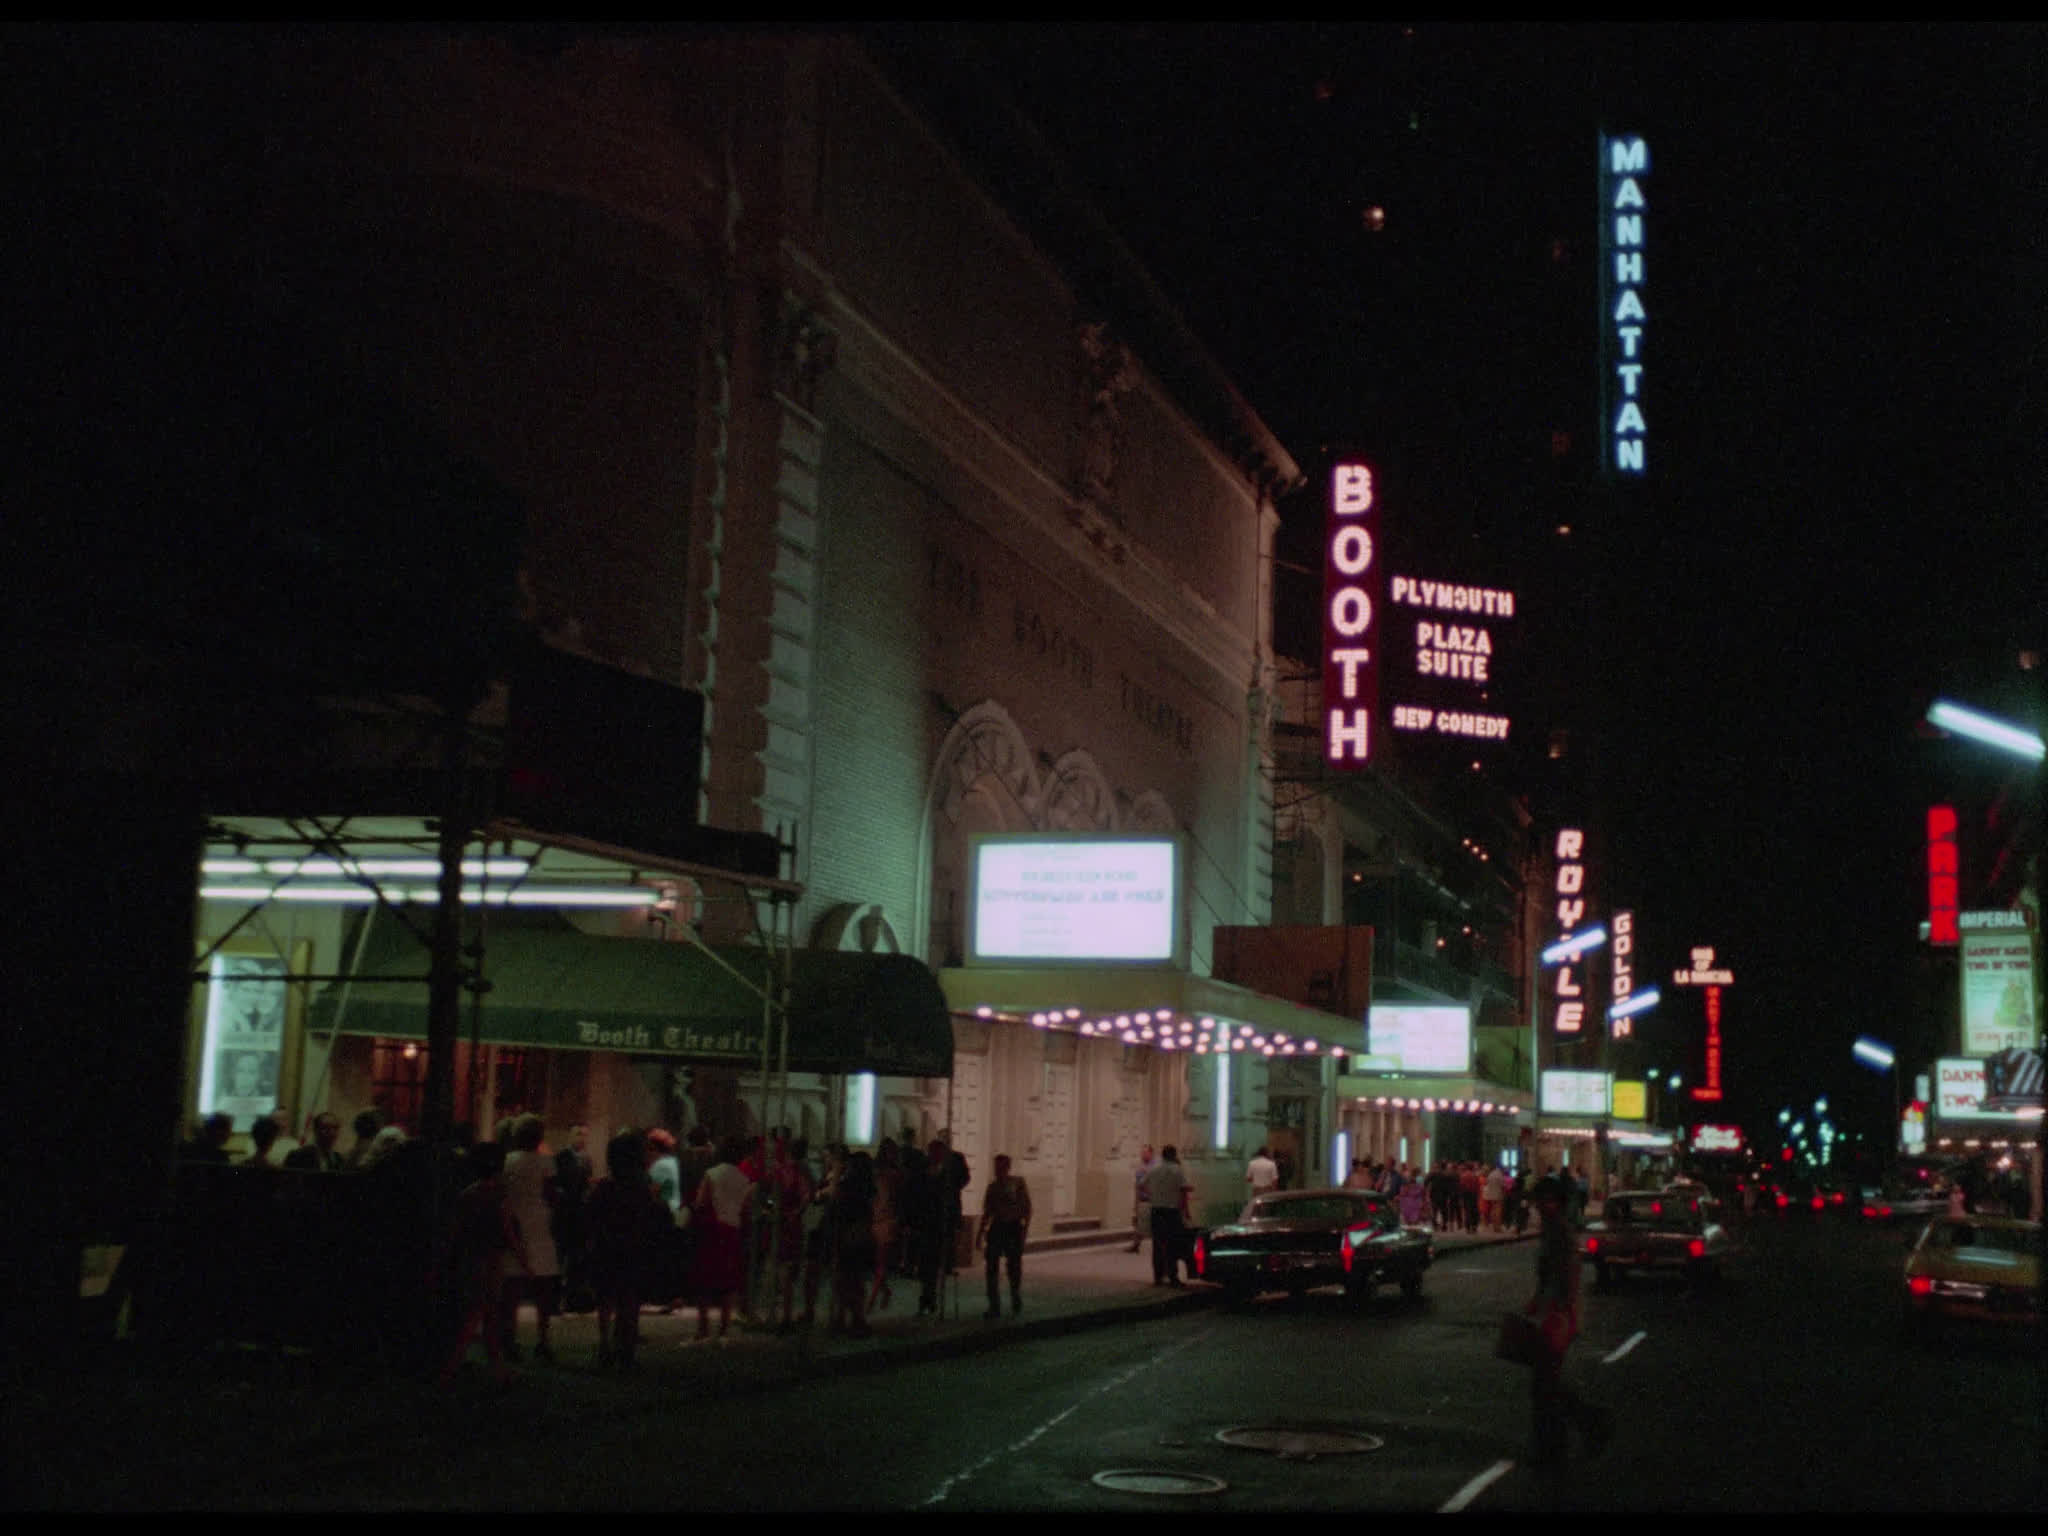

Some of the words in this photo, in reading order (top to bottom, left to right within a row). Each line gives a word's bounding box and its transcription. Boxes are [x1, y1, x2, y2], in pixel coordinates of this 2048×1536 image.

[1611, 139, 1647, 470] MANHATTAN
[1331, 464, 1373, 759] BOOTH
[1392, 576, 1514, 617] PLYMOUTH
[1417, 622, 1492, 655] PLAZA
[1417, 650, 1489, 682] SUITE
[1393, 706, 1433, 730] NEW
[1436, 711, 1510, 740] COMEDY
[1927, 806, 1958, 943] PARK
[1959, 909, 2027, 928] IMPERIAL
[1612, 912, 1633, 1039] GOLDN
[576, 1019, 650, 1048] Booth
